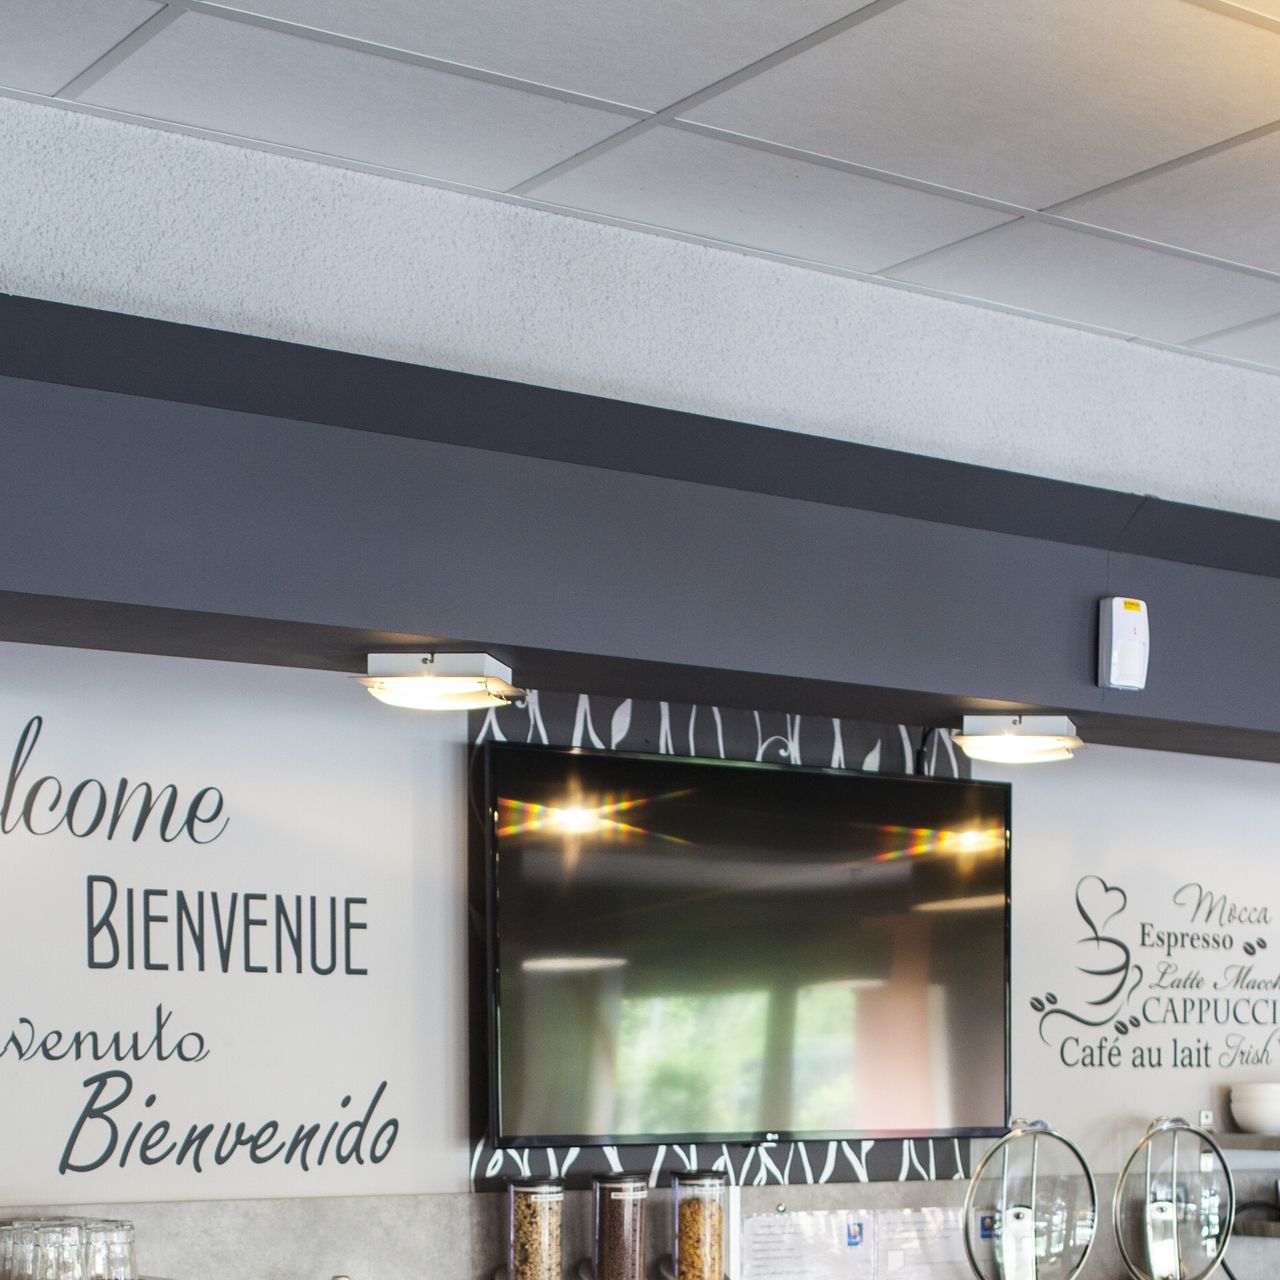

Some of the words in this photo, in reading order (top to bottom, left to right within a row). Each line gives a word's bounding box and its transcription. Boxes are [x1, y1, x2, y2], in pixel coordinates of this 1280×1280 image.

[1173, 882, 1271, 927] Mocca
[86, 874, 369, 977] BIENVENUE
[1140, 922, 1234, 957] Espresso
[1149, 961, 1205, 990] Latte
[1059, 1036, 1122, 1068] Café
[1131, 1046, 1162, 1068] au
[1172, 1038, 1213, 1068] lait
[58, 1070, 400, 1175] Bienvenido
